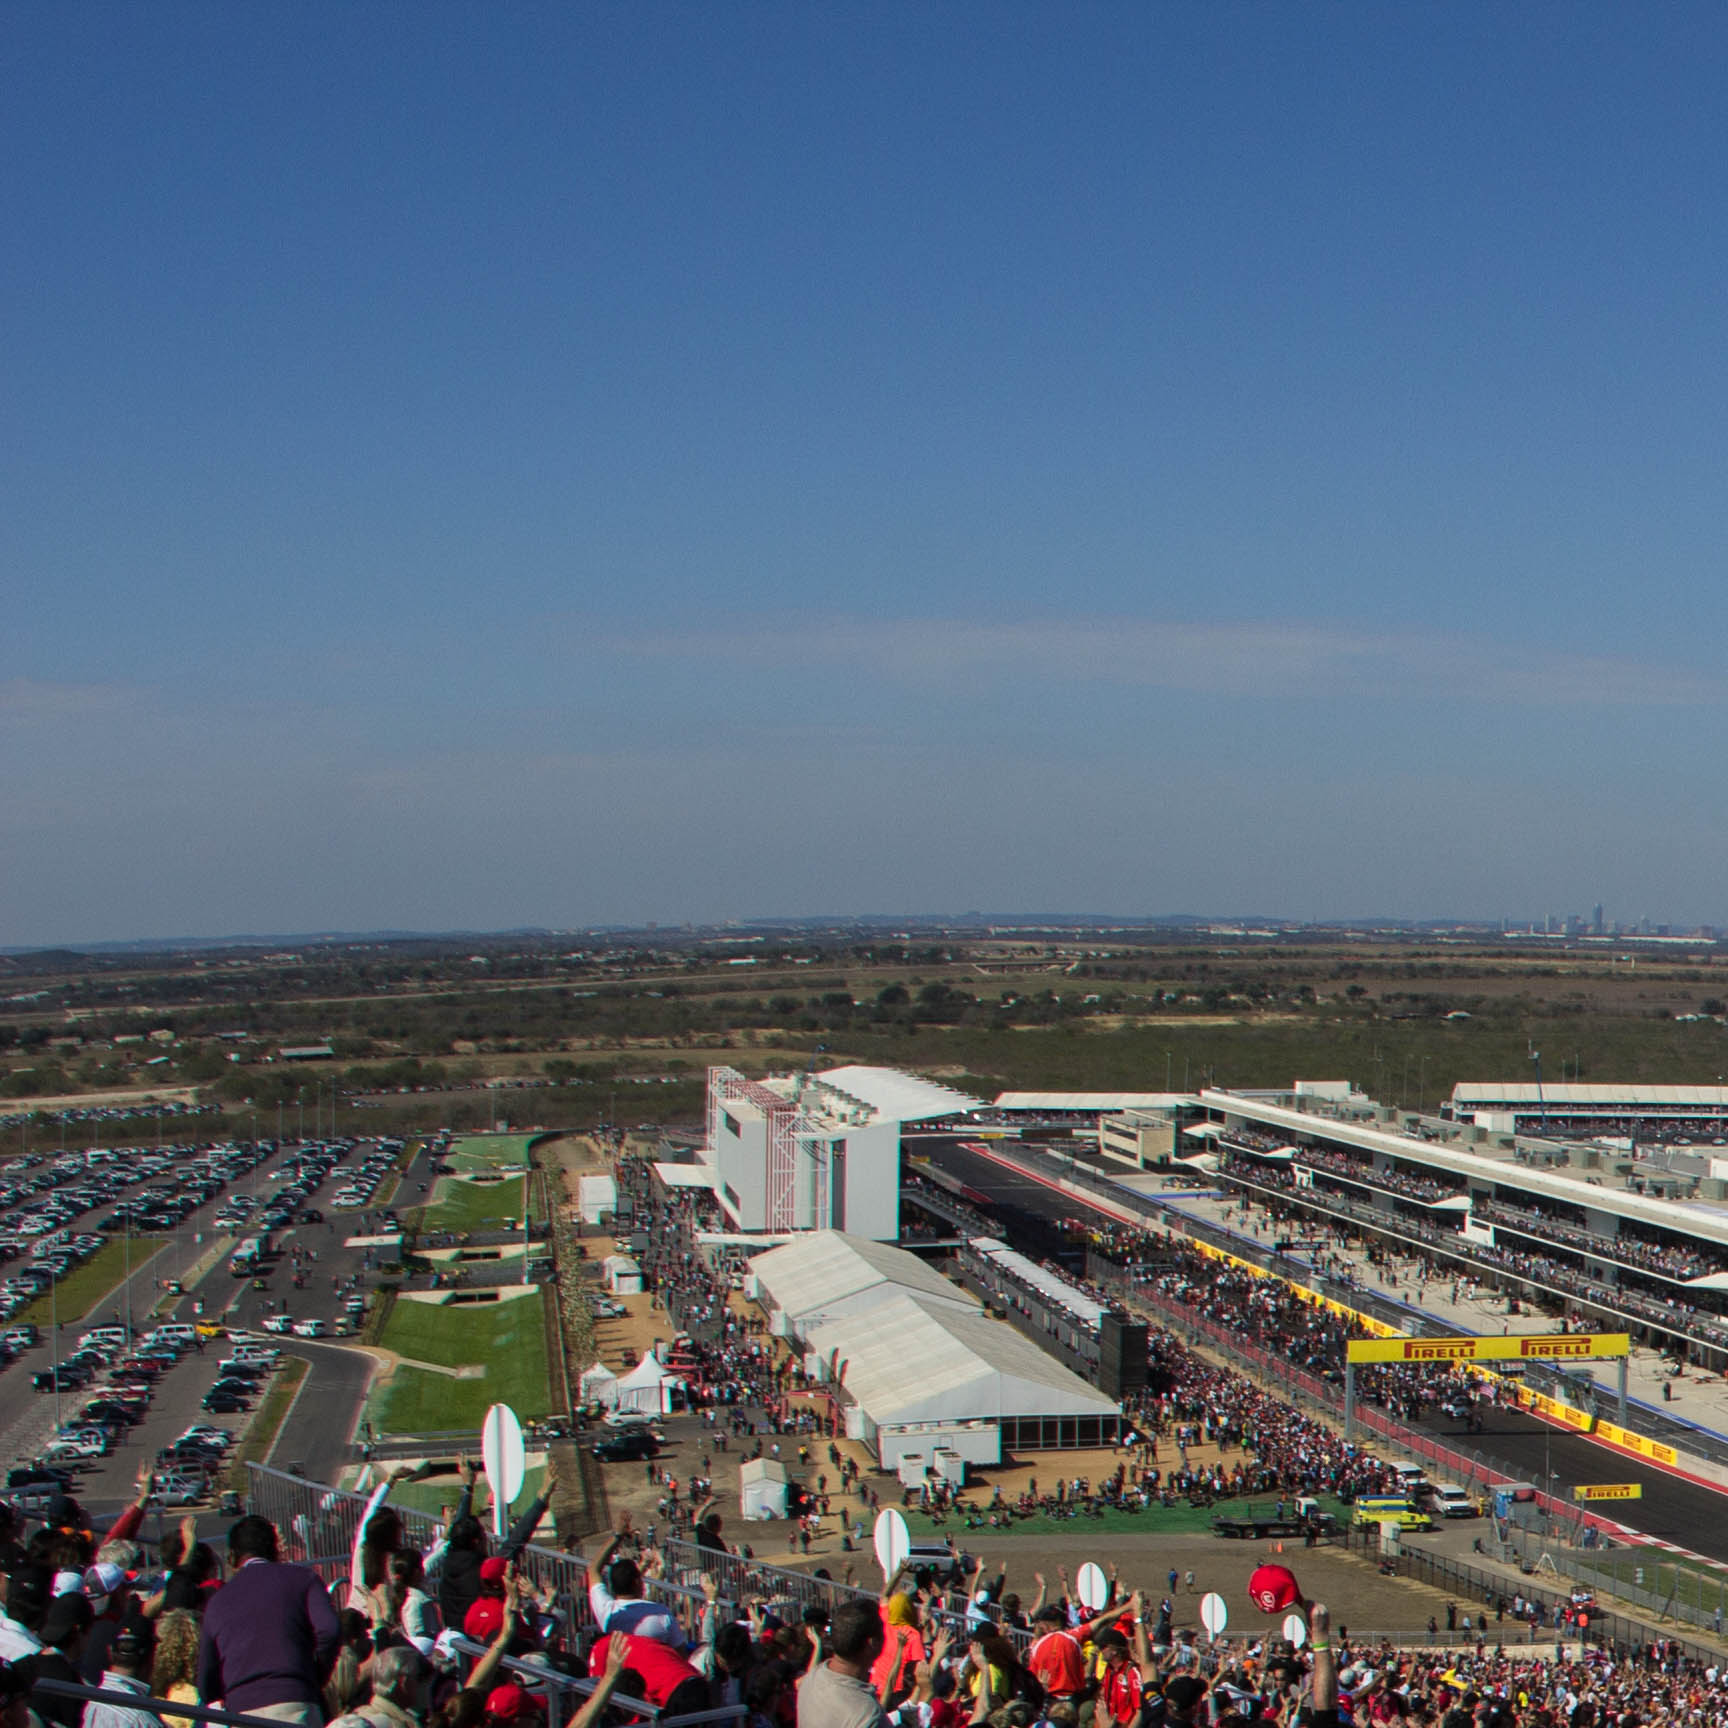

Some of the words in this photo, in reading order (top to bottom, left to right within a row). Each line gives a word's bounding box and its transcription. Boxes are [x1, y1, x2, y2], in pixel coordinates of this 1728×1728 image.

[1404, 1340, 1476, 1359] PIRELLI
[1521, 1338, 1592, 1356] PIRELLI
[1586, 1486, 1631, 1498] PIRELLI
